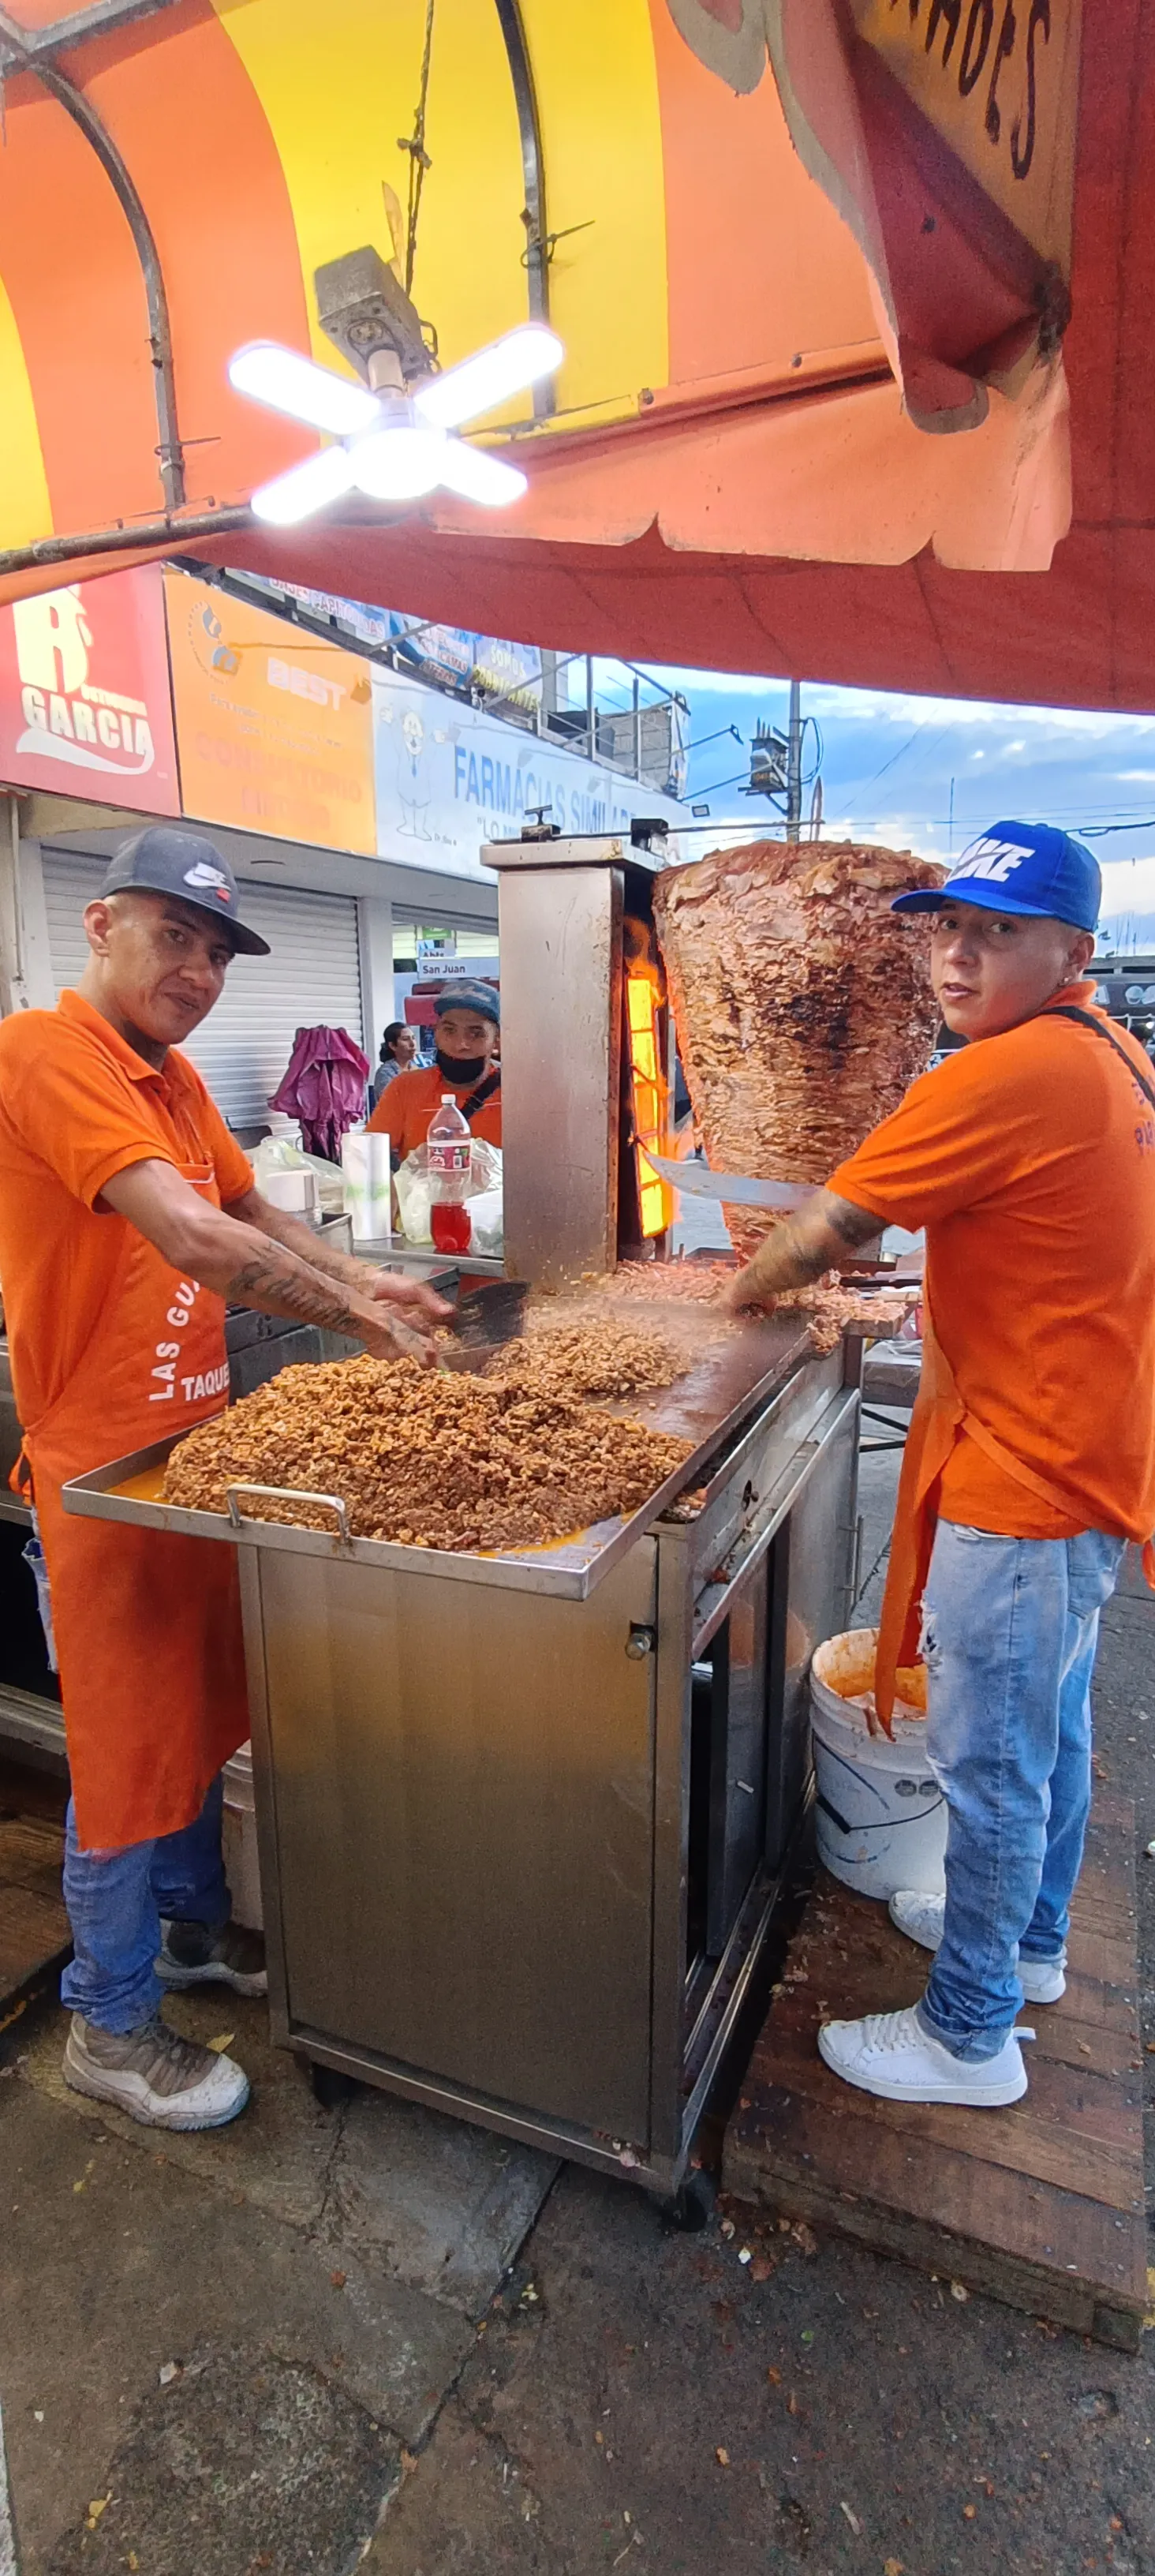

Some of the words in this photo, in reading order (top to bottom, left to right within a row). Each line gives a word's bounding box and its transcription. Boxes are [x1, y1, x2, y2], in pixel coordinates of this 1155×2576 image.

[267, 656, 347, 711] BEST
[21, 685, 153, 756] GARCIA
[454, 744, 566, 829] FARMACIAS
[570, 790, 637, 833] SIMILAR
[422, 964, 440, 975] San
[442, 964, 465, 974] Juan
[148, 1342, 181, 1402] LAS
